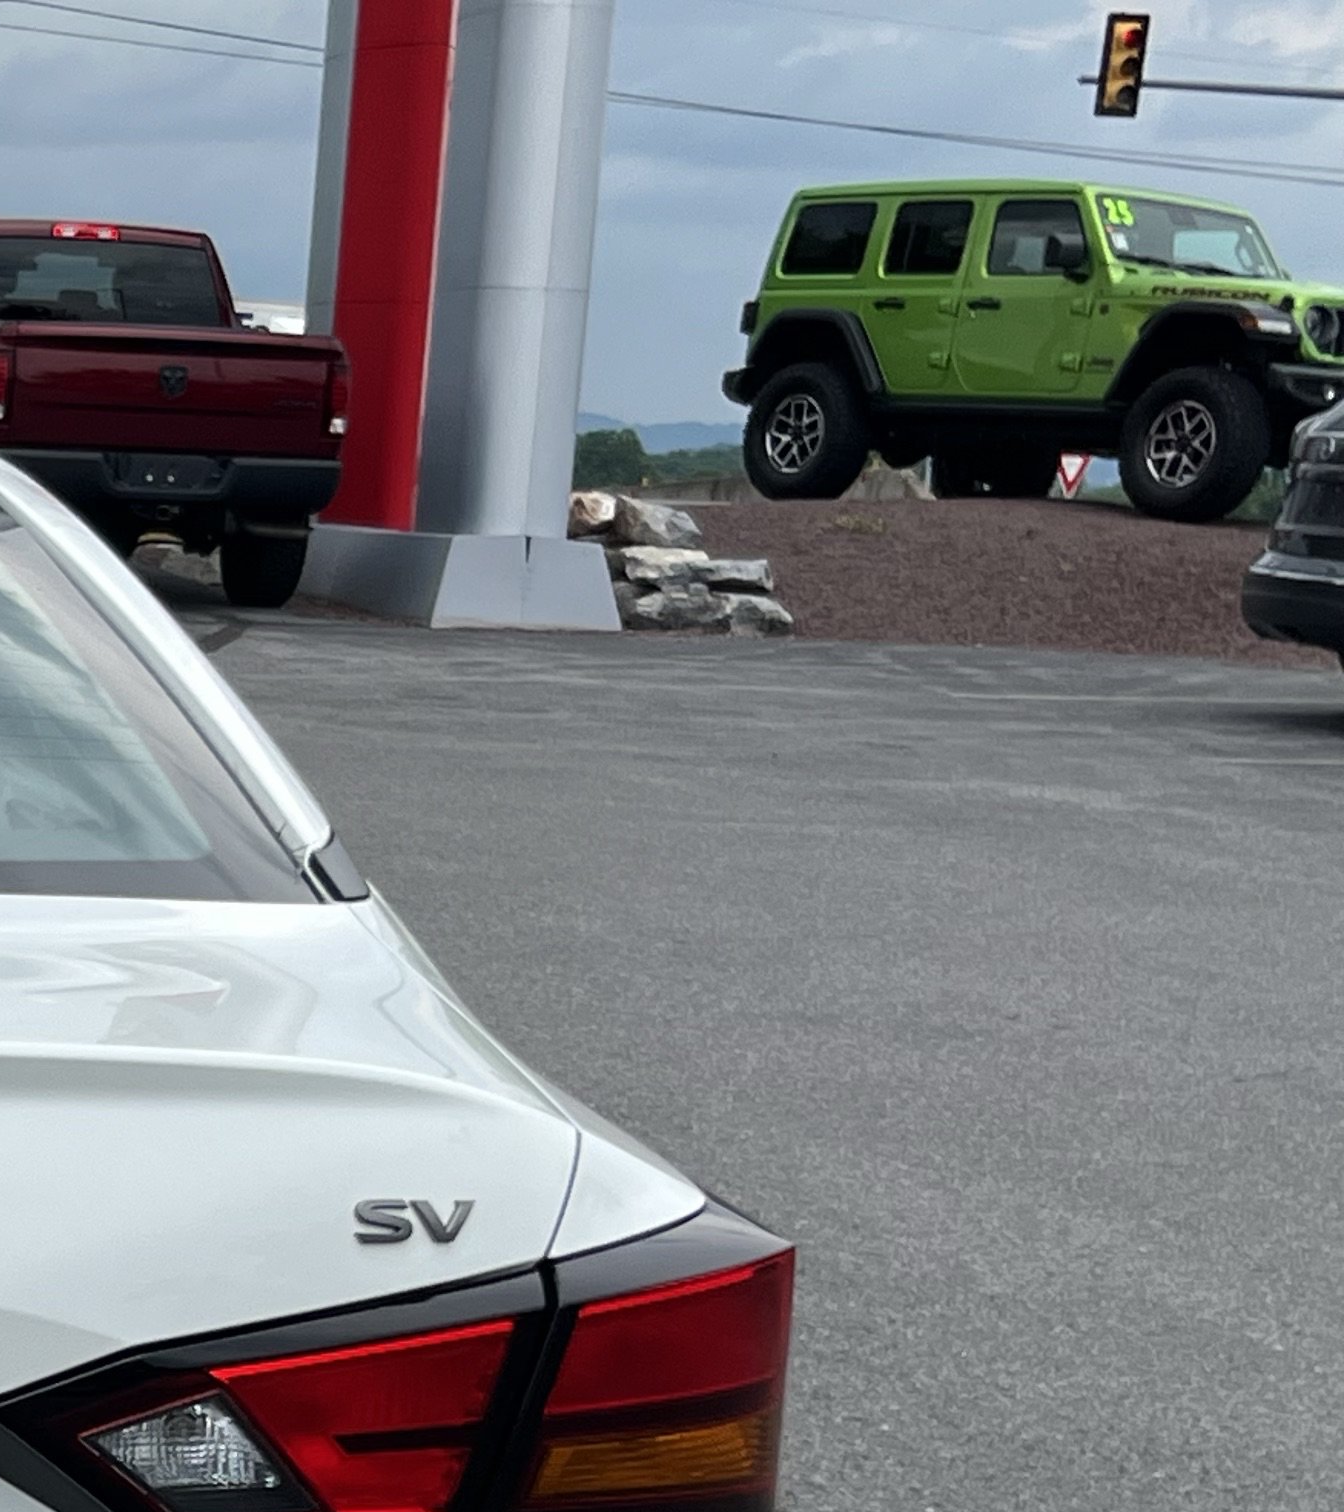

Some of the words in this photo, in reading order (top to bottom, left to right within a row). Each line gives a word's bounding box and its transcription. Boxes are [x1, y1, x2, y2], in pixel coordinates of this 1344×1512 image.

[1103, 197, 1135, 227] 25
[1152, 286, 1270, 301] RUBICON
[353, 1198, 476, 1244] SV
